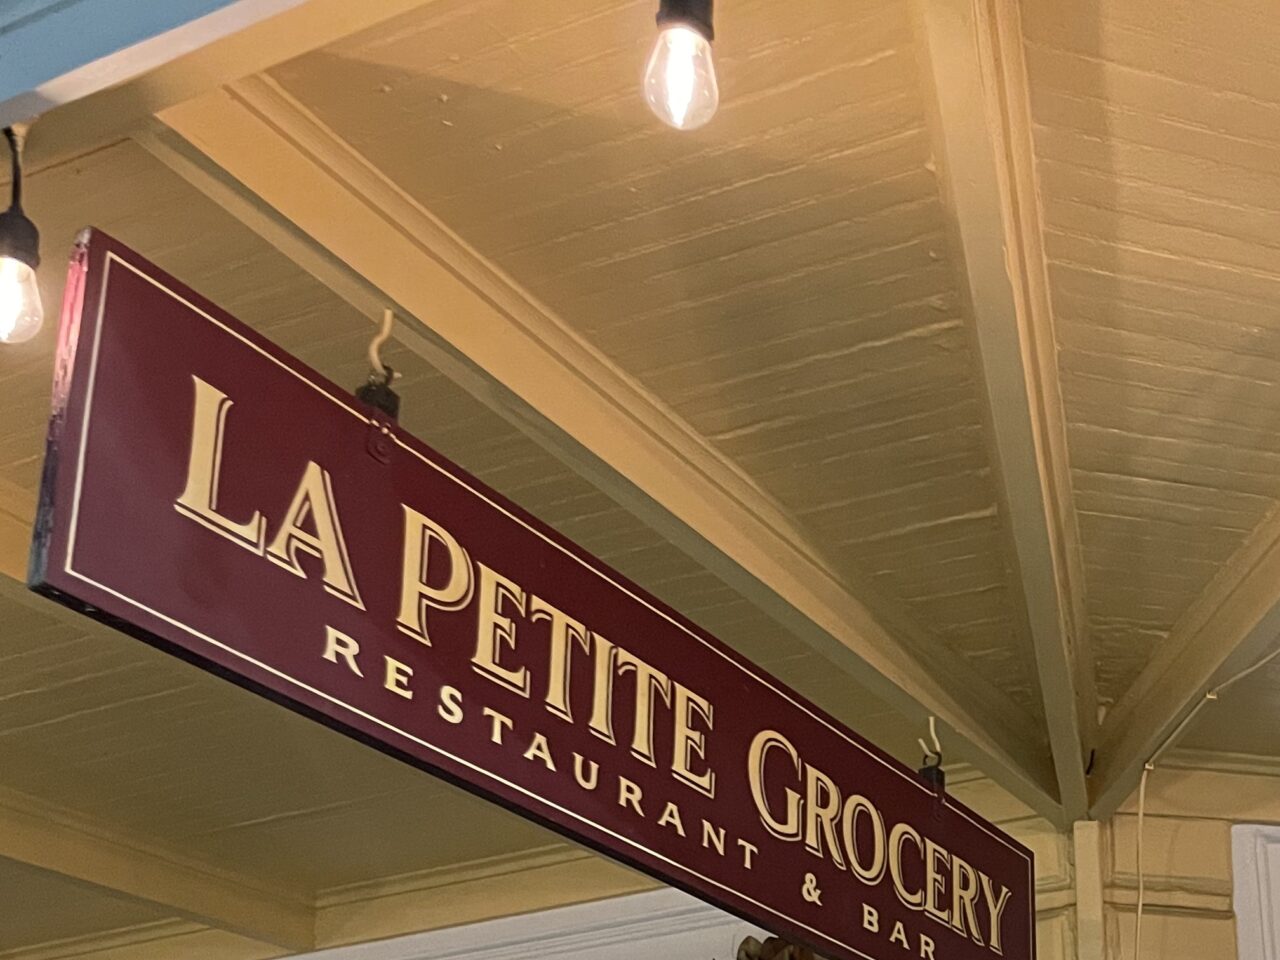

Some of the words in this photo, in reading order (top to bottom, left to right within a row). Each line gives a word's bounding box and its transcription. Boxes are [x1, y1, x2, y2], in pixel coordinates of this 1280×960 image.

[174, 374, 366, 611] LA
[396, 502, 715, 799] PETITE
[747, 729, 1012, 957] GROCERY
[322, 624, 759, 870] RESTAURANT
[801, 872, 823, 907] &
